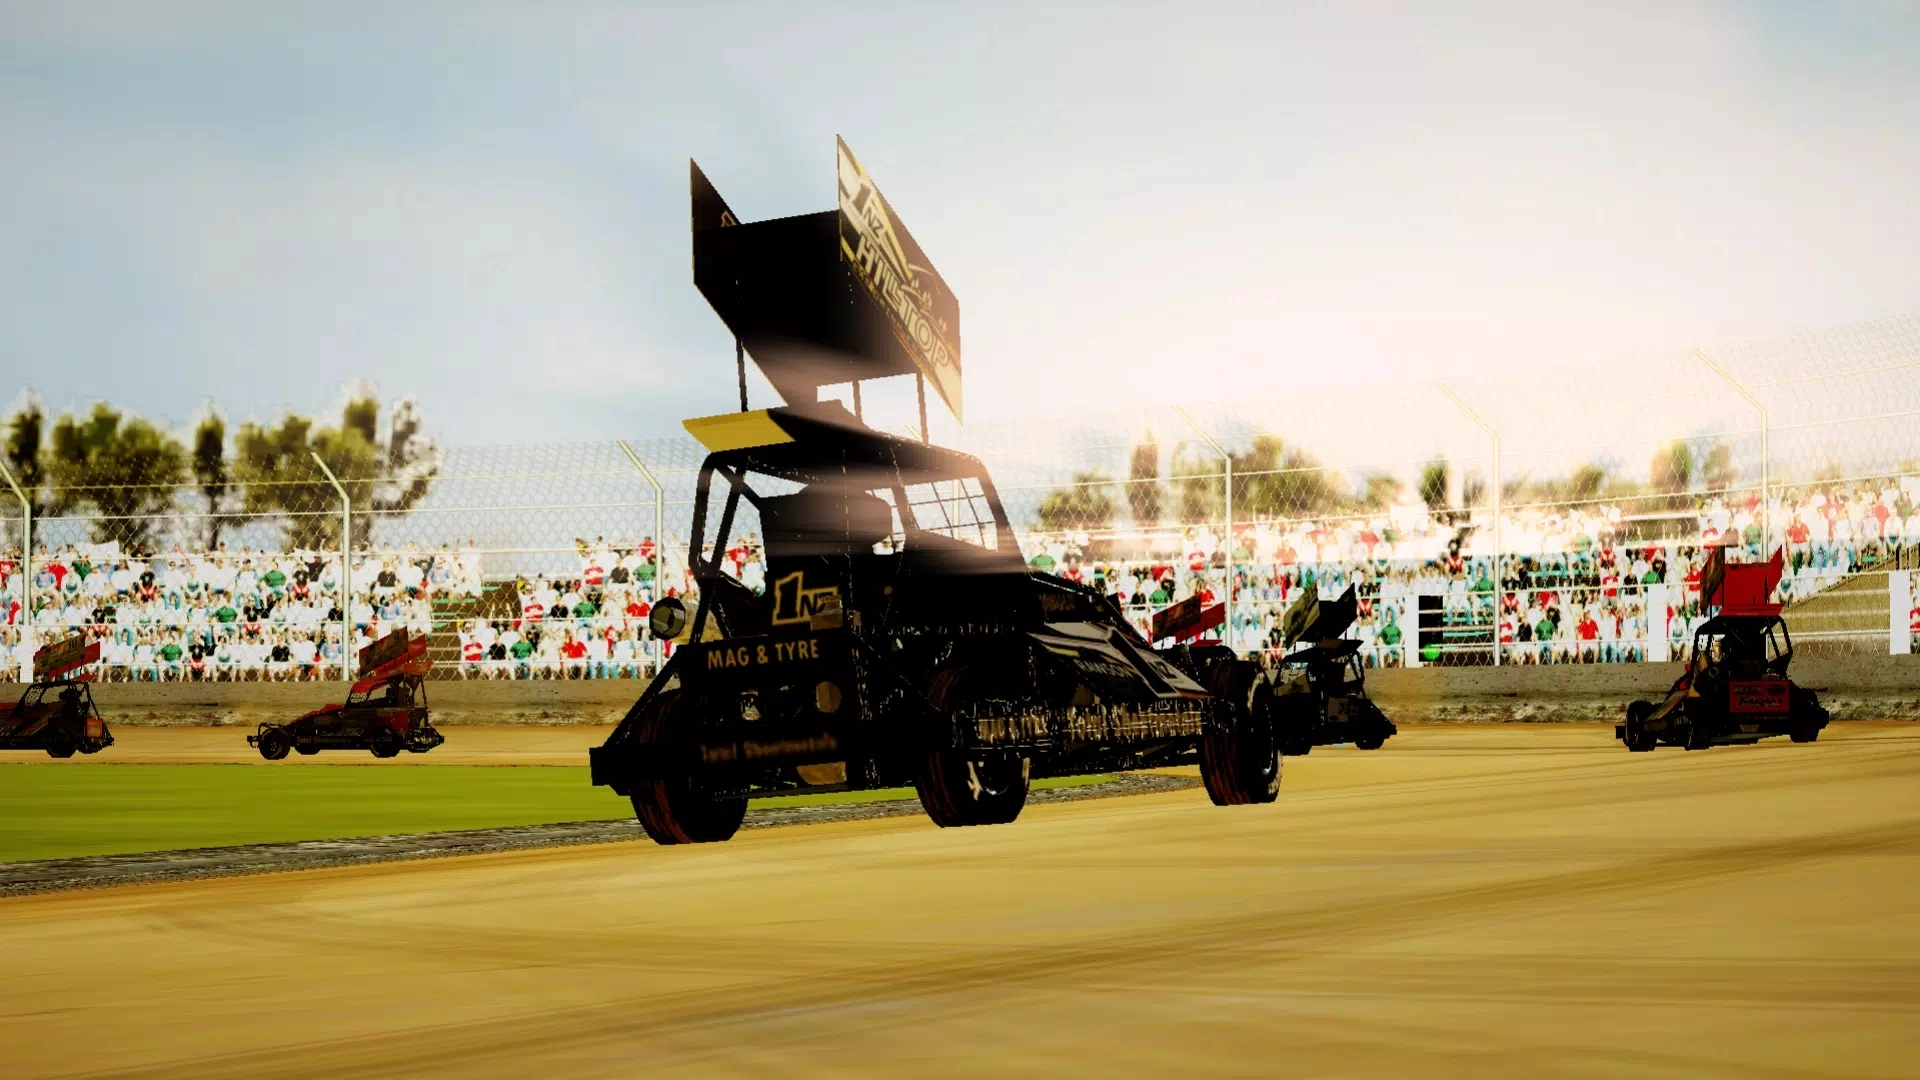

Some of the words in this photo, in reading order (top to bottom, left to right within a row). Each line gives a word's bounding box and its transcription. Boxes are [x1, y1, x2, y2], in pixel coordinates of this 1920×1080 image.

[707, 646, 750, 670] MAG
[756, 644, 769, 664] &
[774, 639, 820, 662] TYRE
